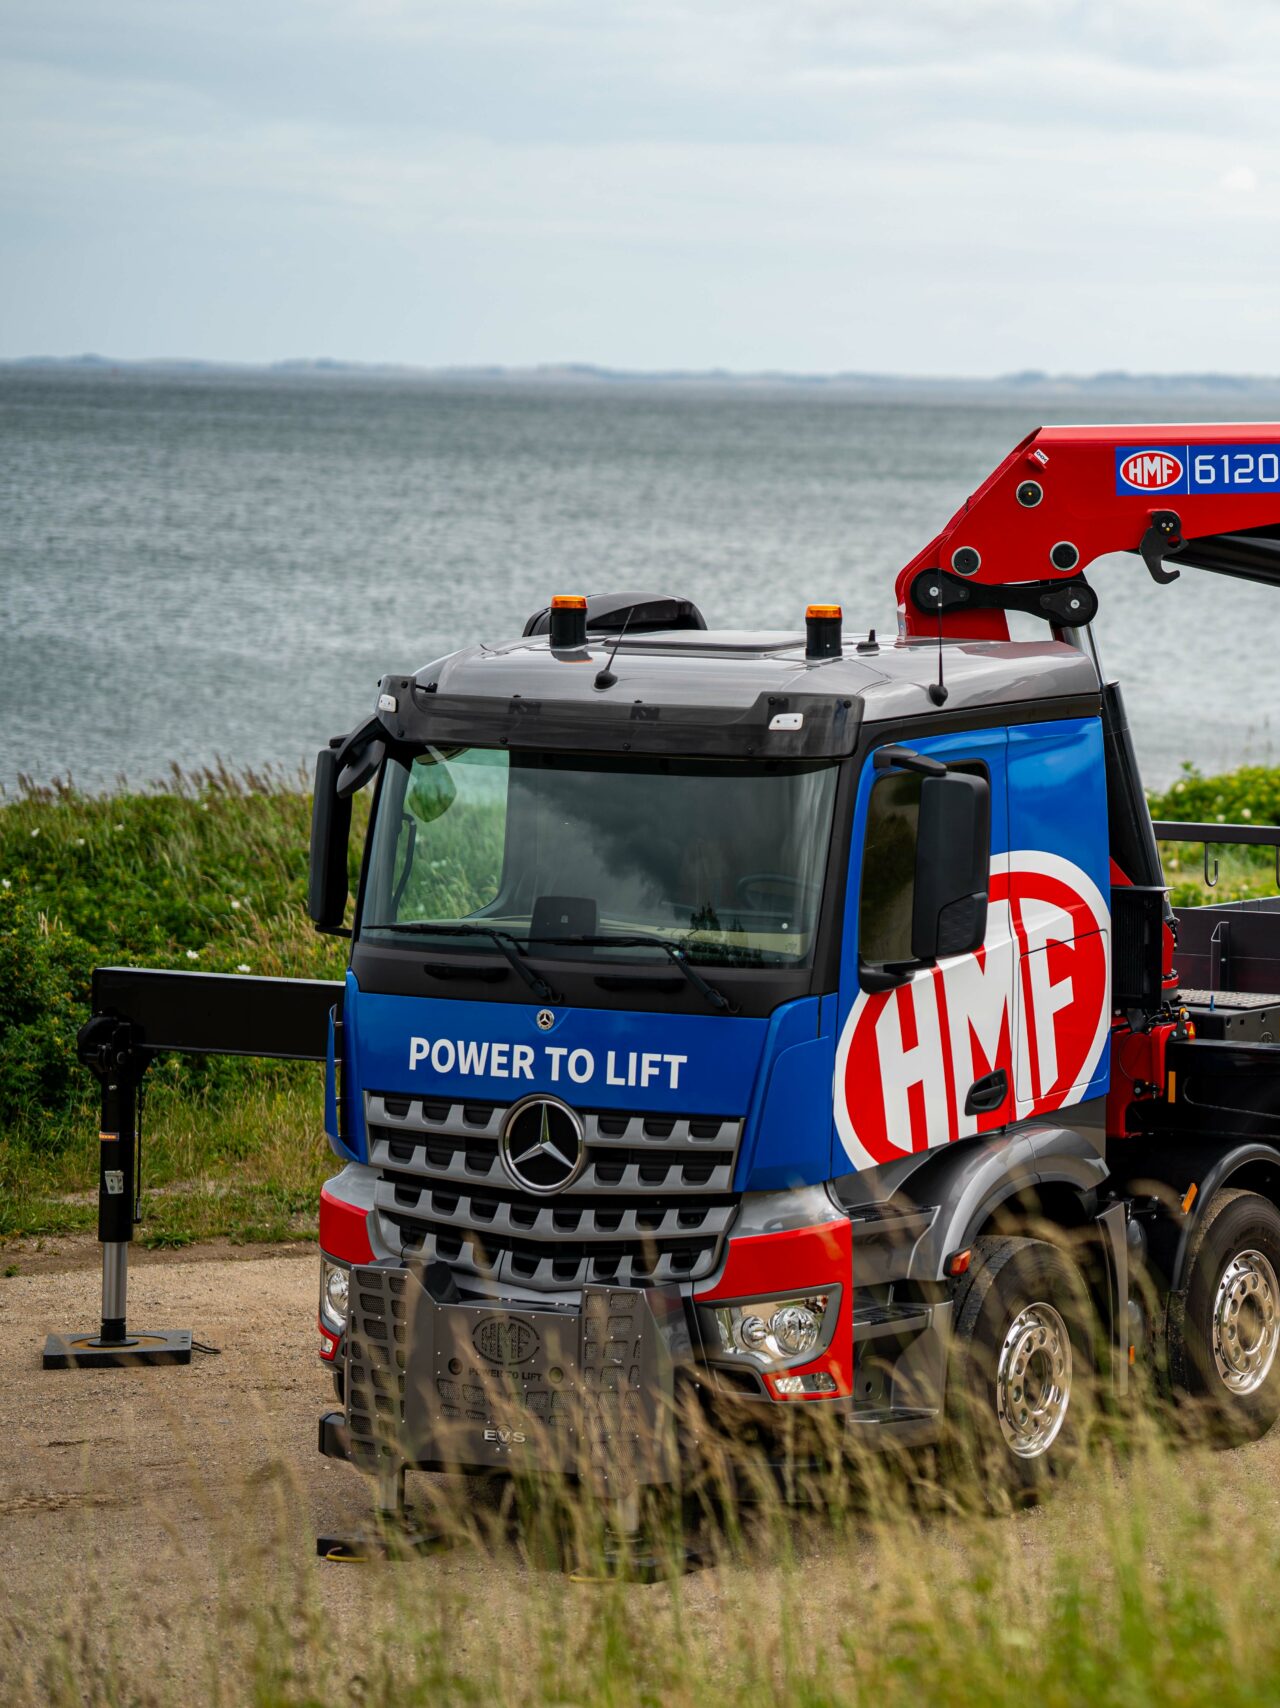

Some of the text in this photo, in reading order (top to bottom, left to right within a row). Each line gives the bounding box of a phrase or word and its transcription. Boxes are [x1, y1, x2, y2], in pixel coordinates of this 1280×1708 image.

[1128, 453, 1279, 485] HMF 6120
[875, 897, 1076, 1154] HMF
[408, 1036, 688, 1089] POWER TO LIFT
[522, 1371, 542, 1382] LIFT
[484, 1428, 526, 1444] EVS
